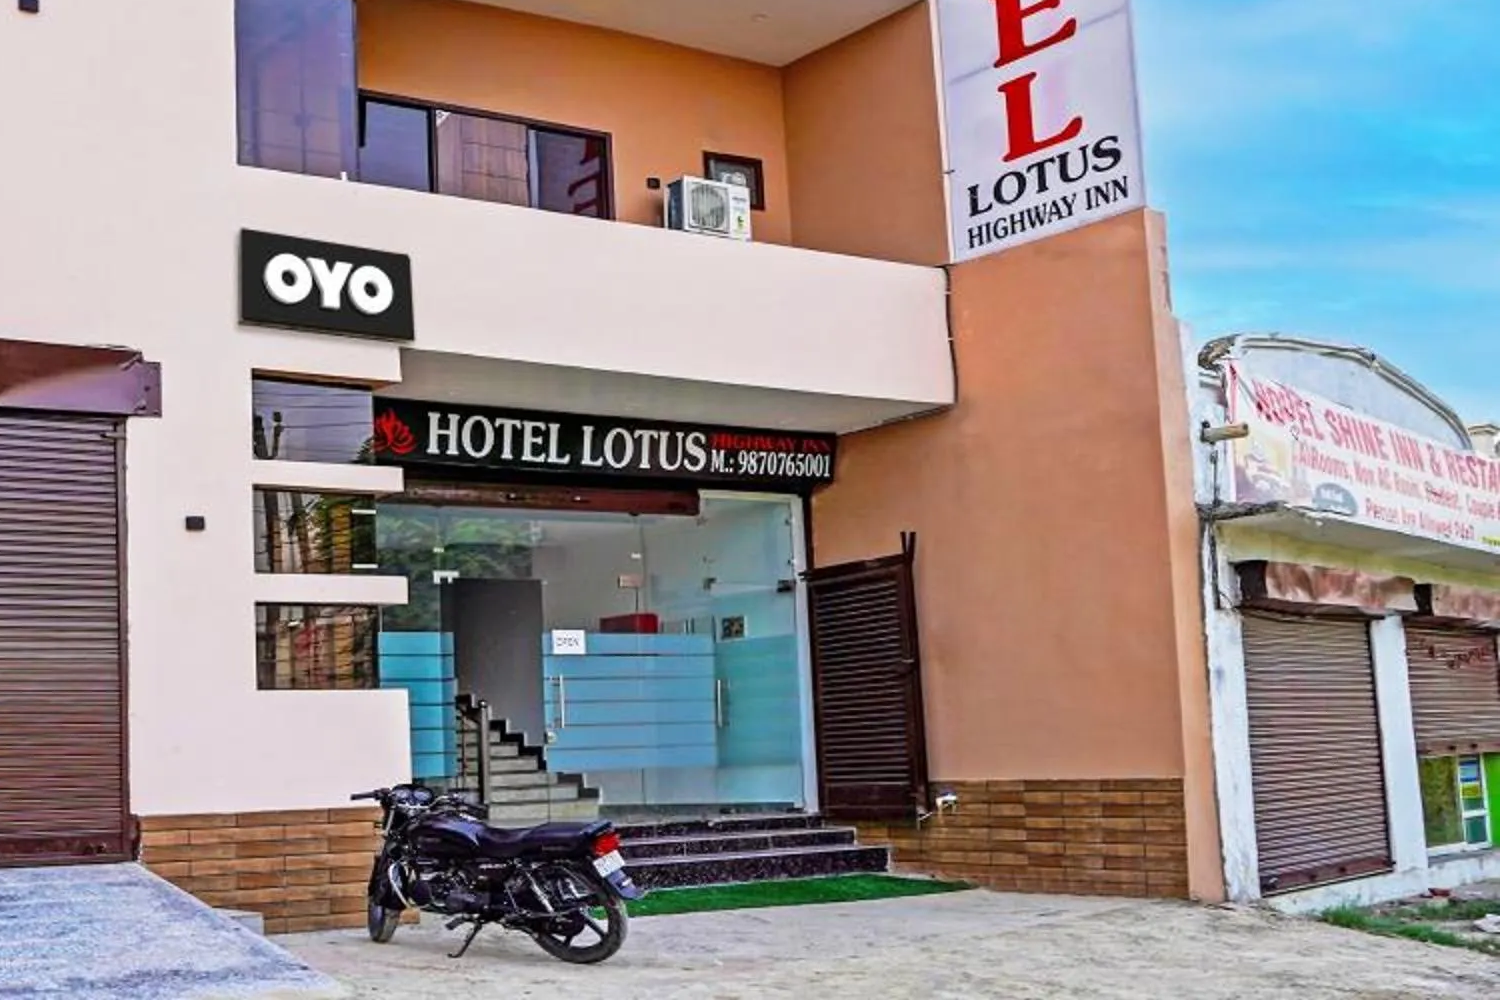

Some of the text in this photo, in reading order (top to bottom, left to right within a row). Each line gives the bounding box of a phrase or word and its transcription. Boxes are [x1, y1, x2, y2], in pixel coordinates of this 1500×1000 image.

[967, 135, 1122, 217] LOTUS
[967, 175, 1129, 249] HIGHWAY INN
[262, 253, 394, 315] OYO
[426, 411, 707, 472] HOTEL LOTUS
[710, 449, 831, 477] M.: 9870765001
